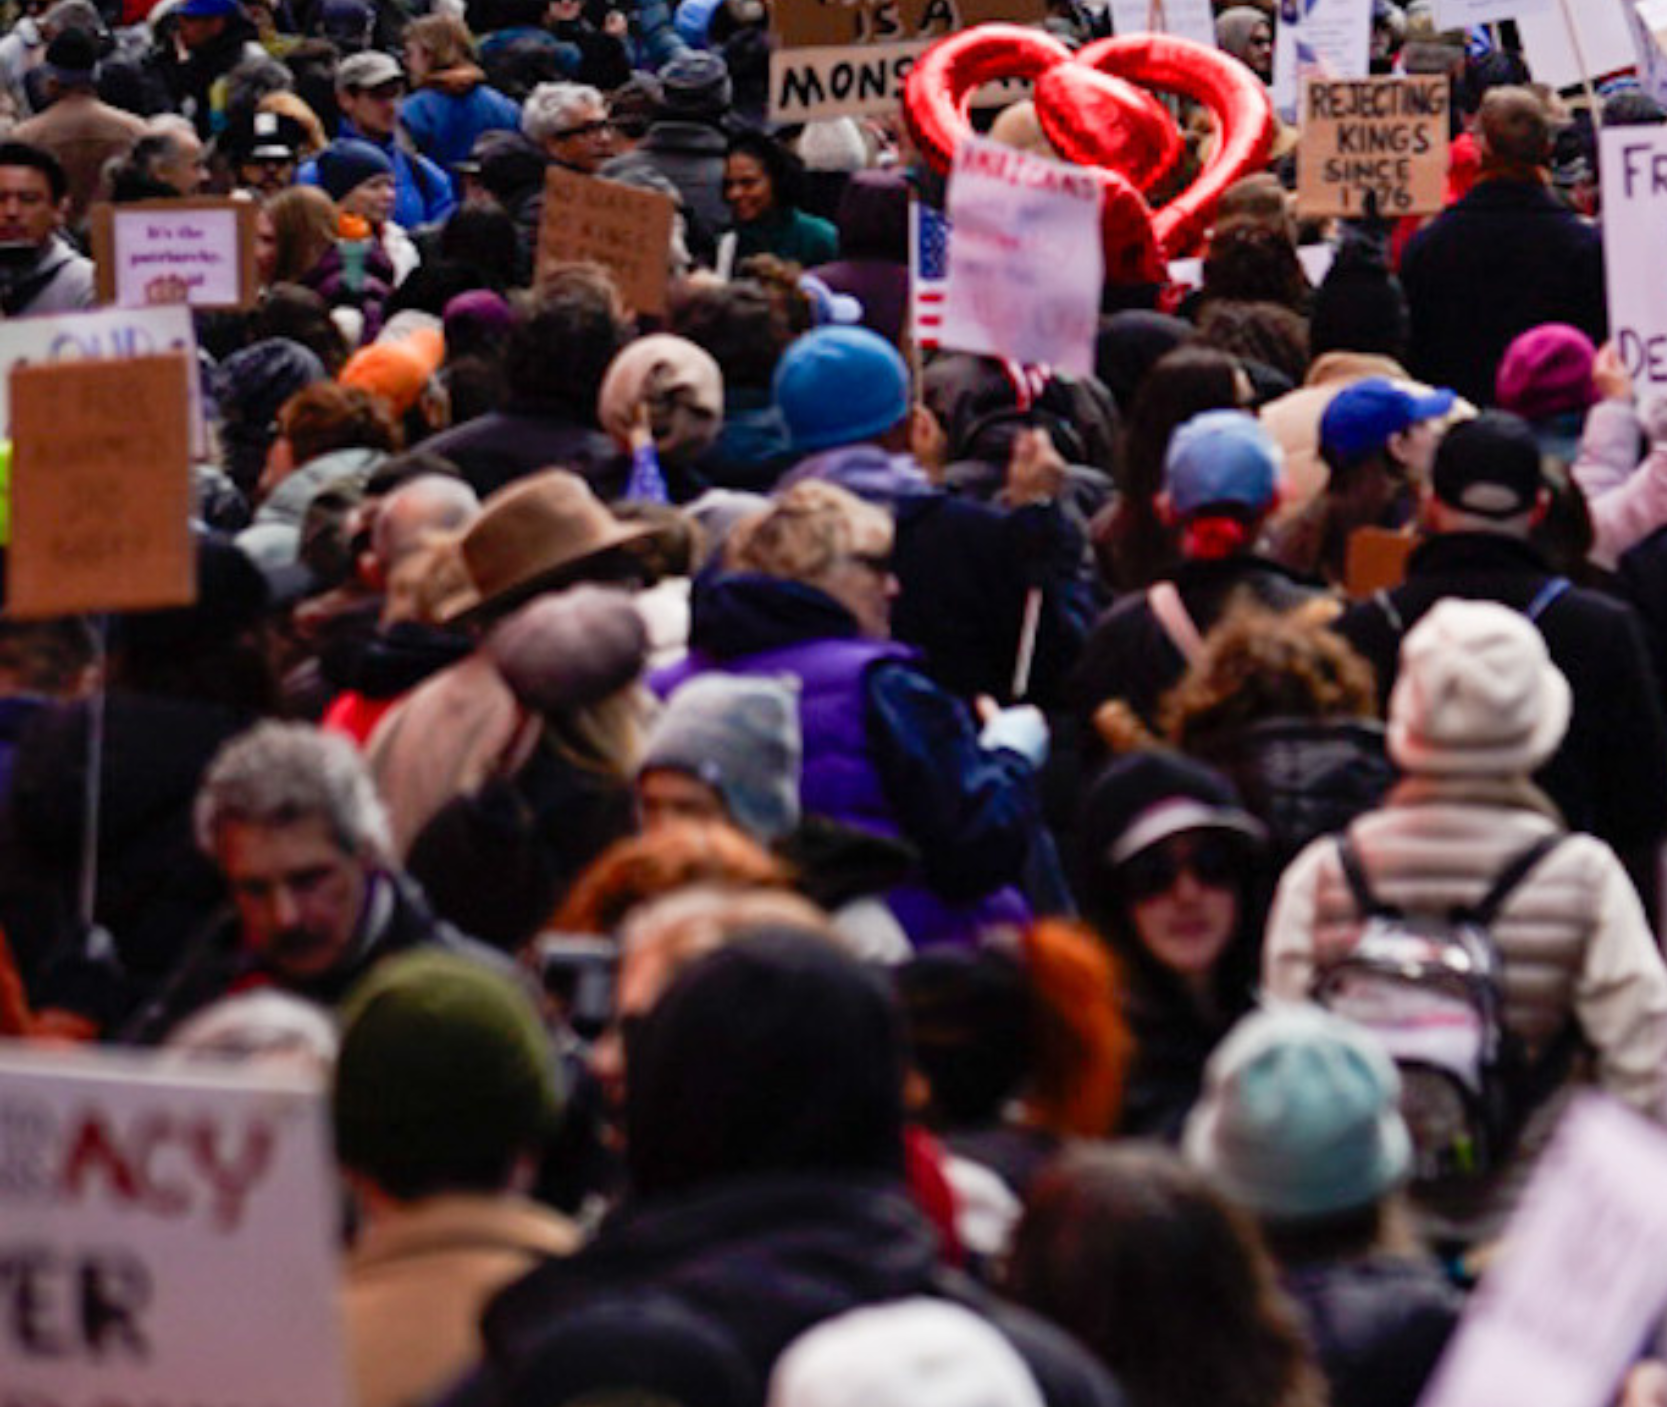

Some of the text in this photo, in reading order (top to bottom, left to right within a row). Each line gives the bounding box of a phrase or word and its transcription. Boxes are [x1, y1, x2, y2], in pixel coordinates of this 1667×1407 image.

[856, 0, 901, 41] IS
[1308, 79, 1448, 120] REJECTING
[1337, 122, 1430, 155] KINGS
[1323, 158, 1410, 183] SINCE
